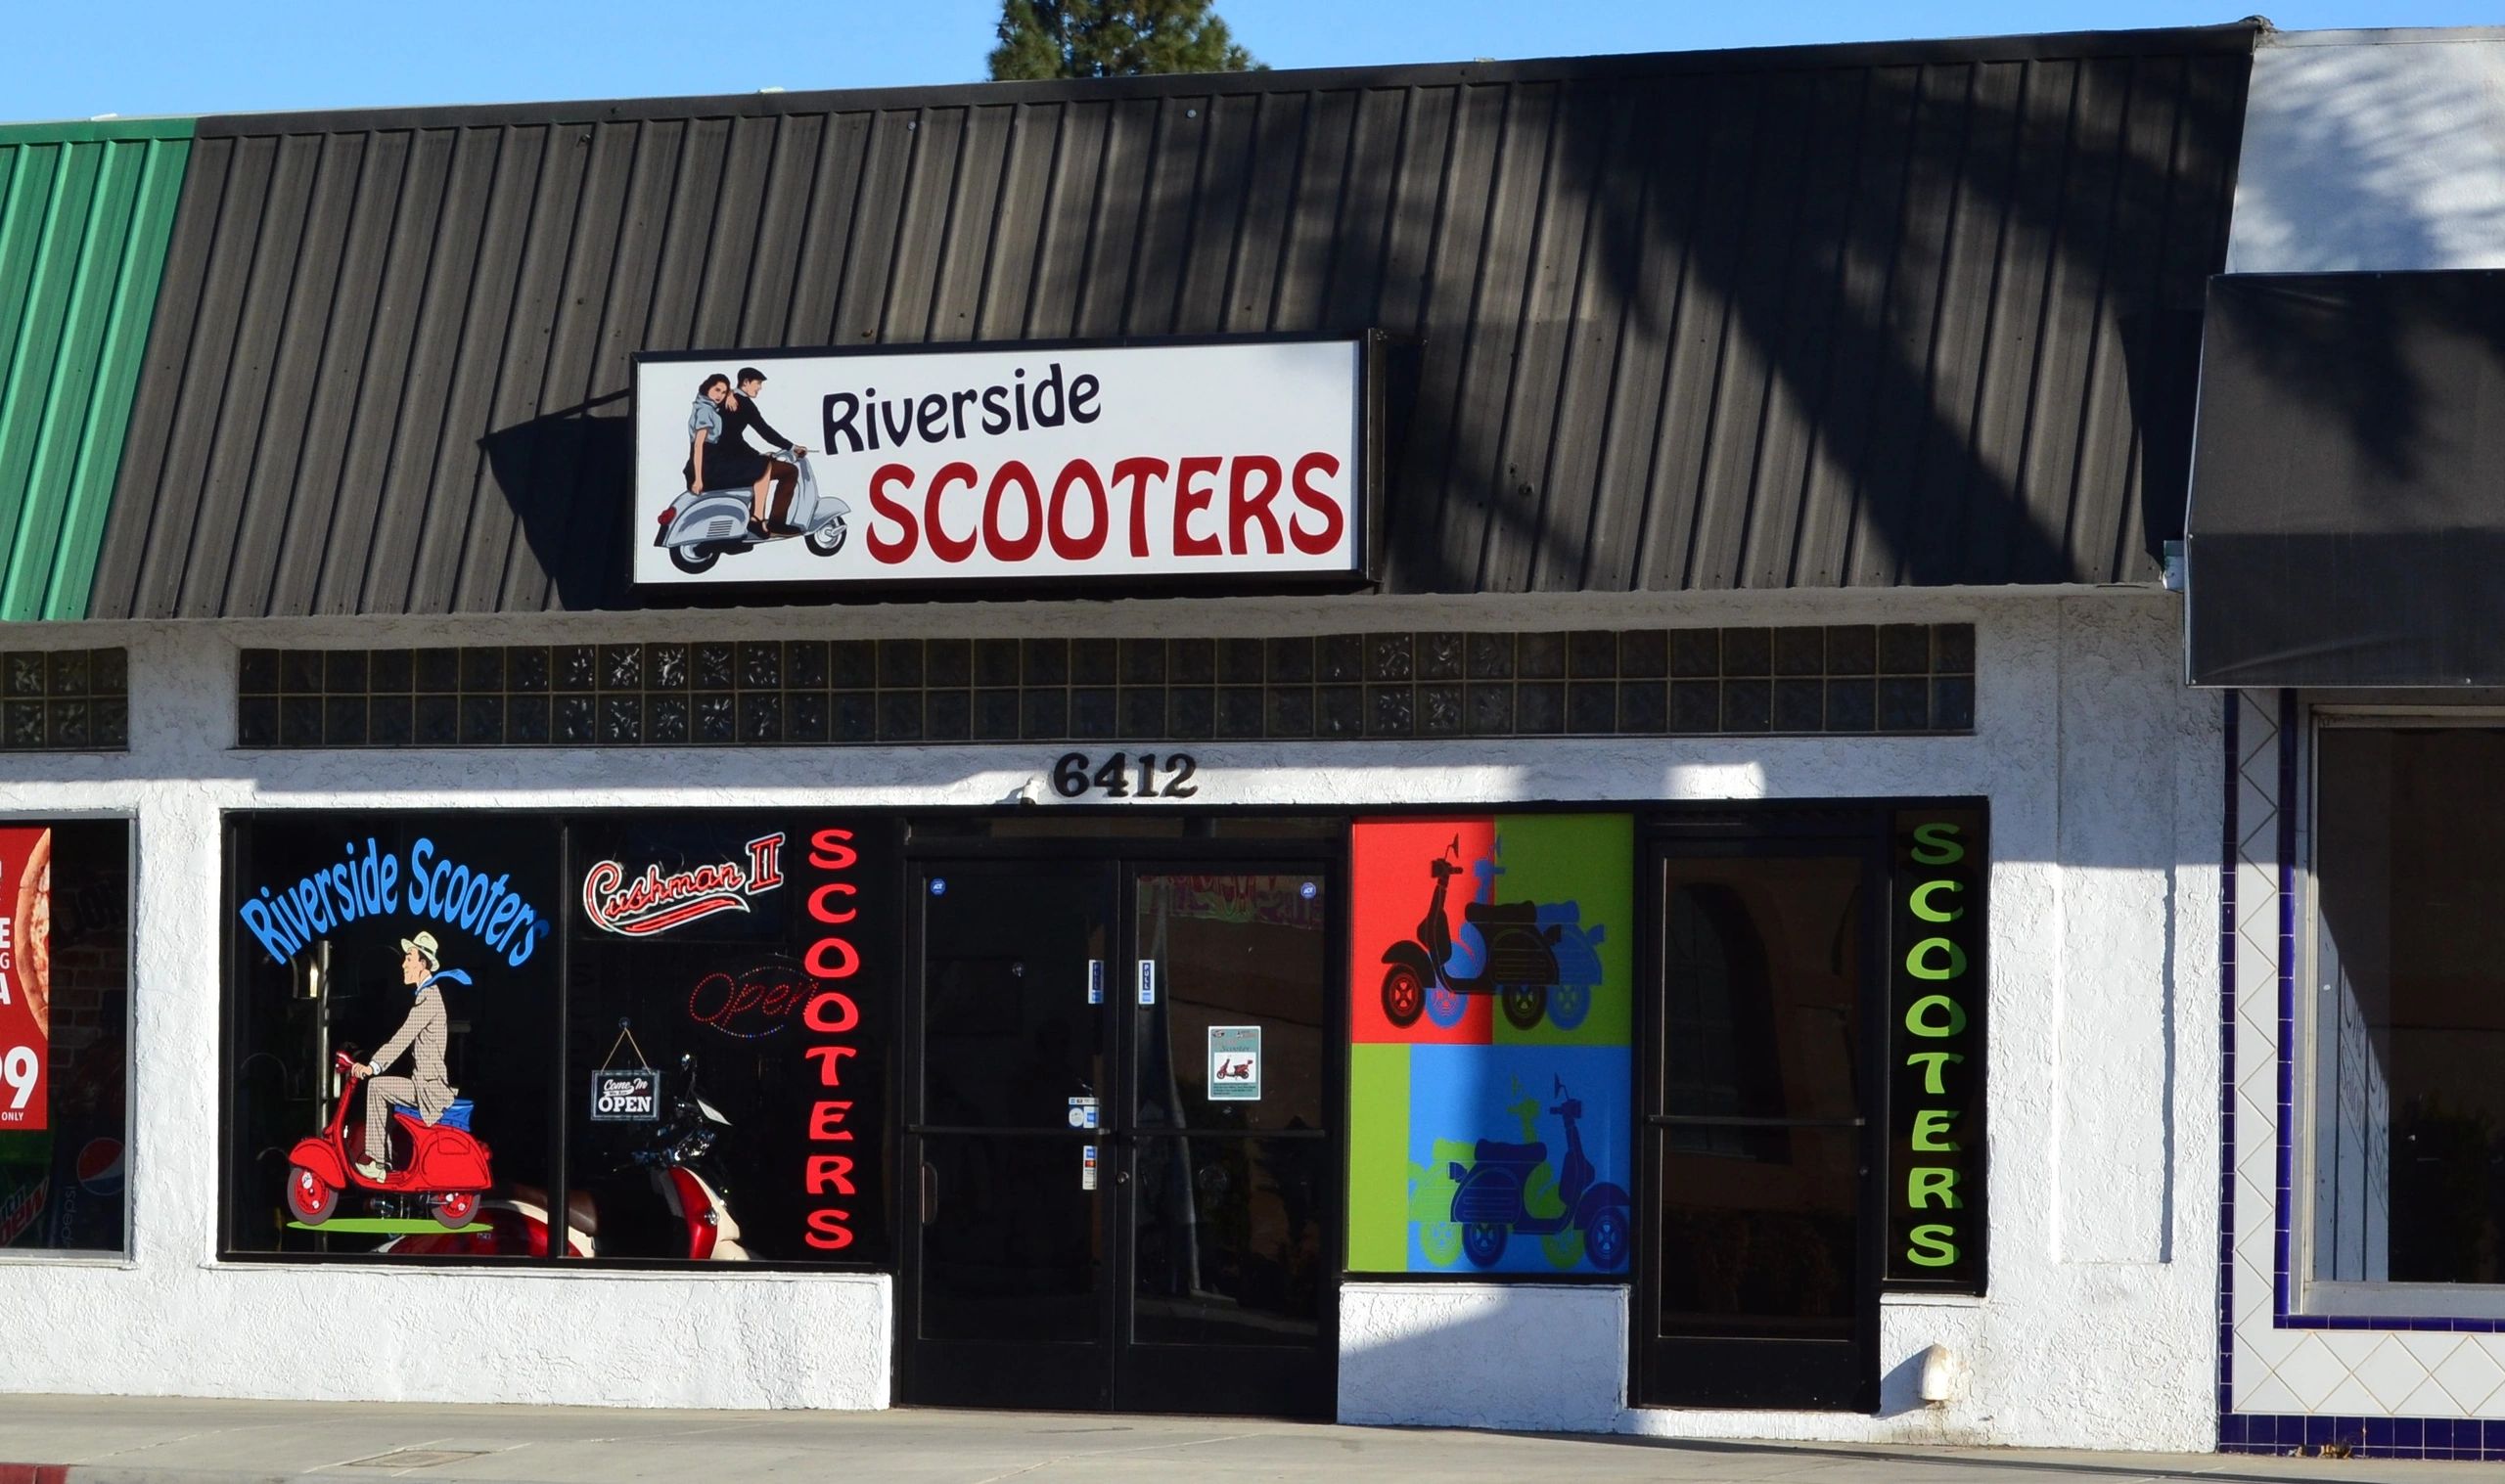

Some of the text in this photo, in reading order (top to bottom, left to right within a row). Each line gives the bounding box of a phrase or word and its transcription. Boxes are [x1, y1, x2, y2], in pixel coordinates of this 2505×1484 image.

[822, 362, 1102, 457] Riverside
[866, 452, 1344, 564] SCOOTERS
[1053, 751, 1199, 798] 6412
[240, 837, 549, 967] Riverside Scooters
[583, 860, 746, 932] Cushman
[803, 829, 859, 1249] SCOOTERS
[1906, 822, 1967, 1267] SCOOTERS
[1, 1111, 23, 1121] ONLY
[598, 1096, 653, 1113] OPEN
[603, 1077, 649, 1092] Come In
